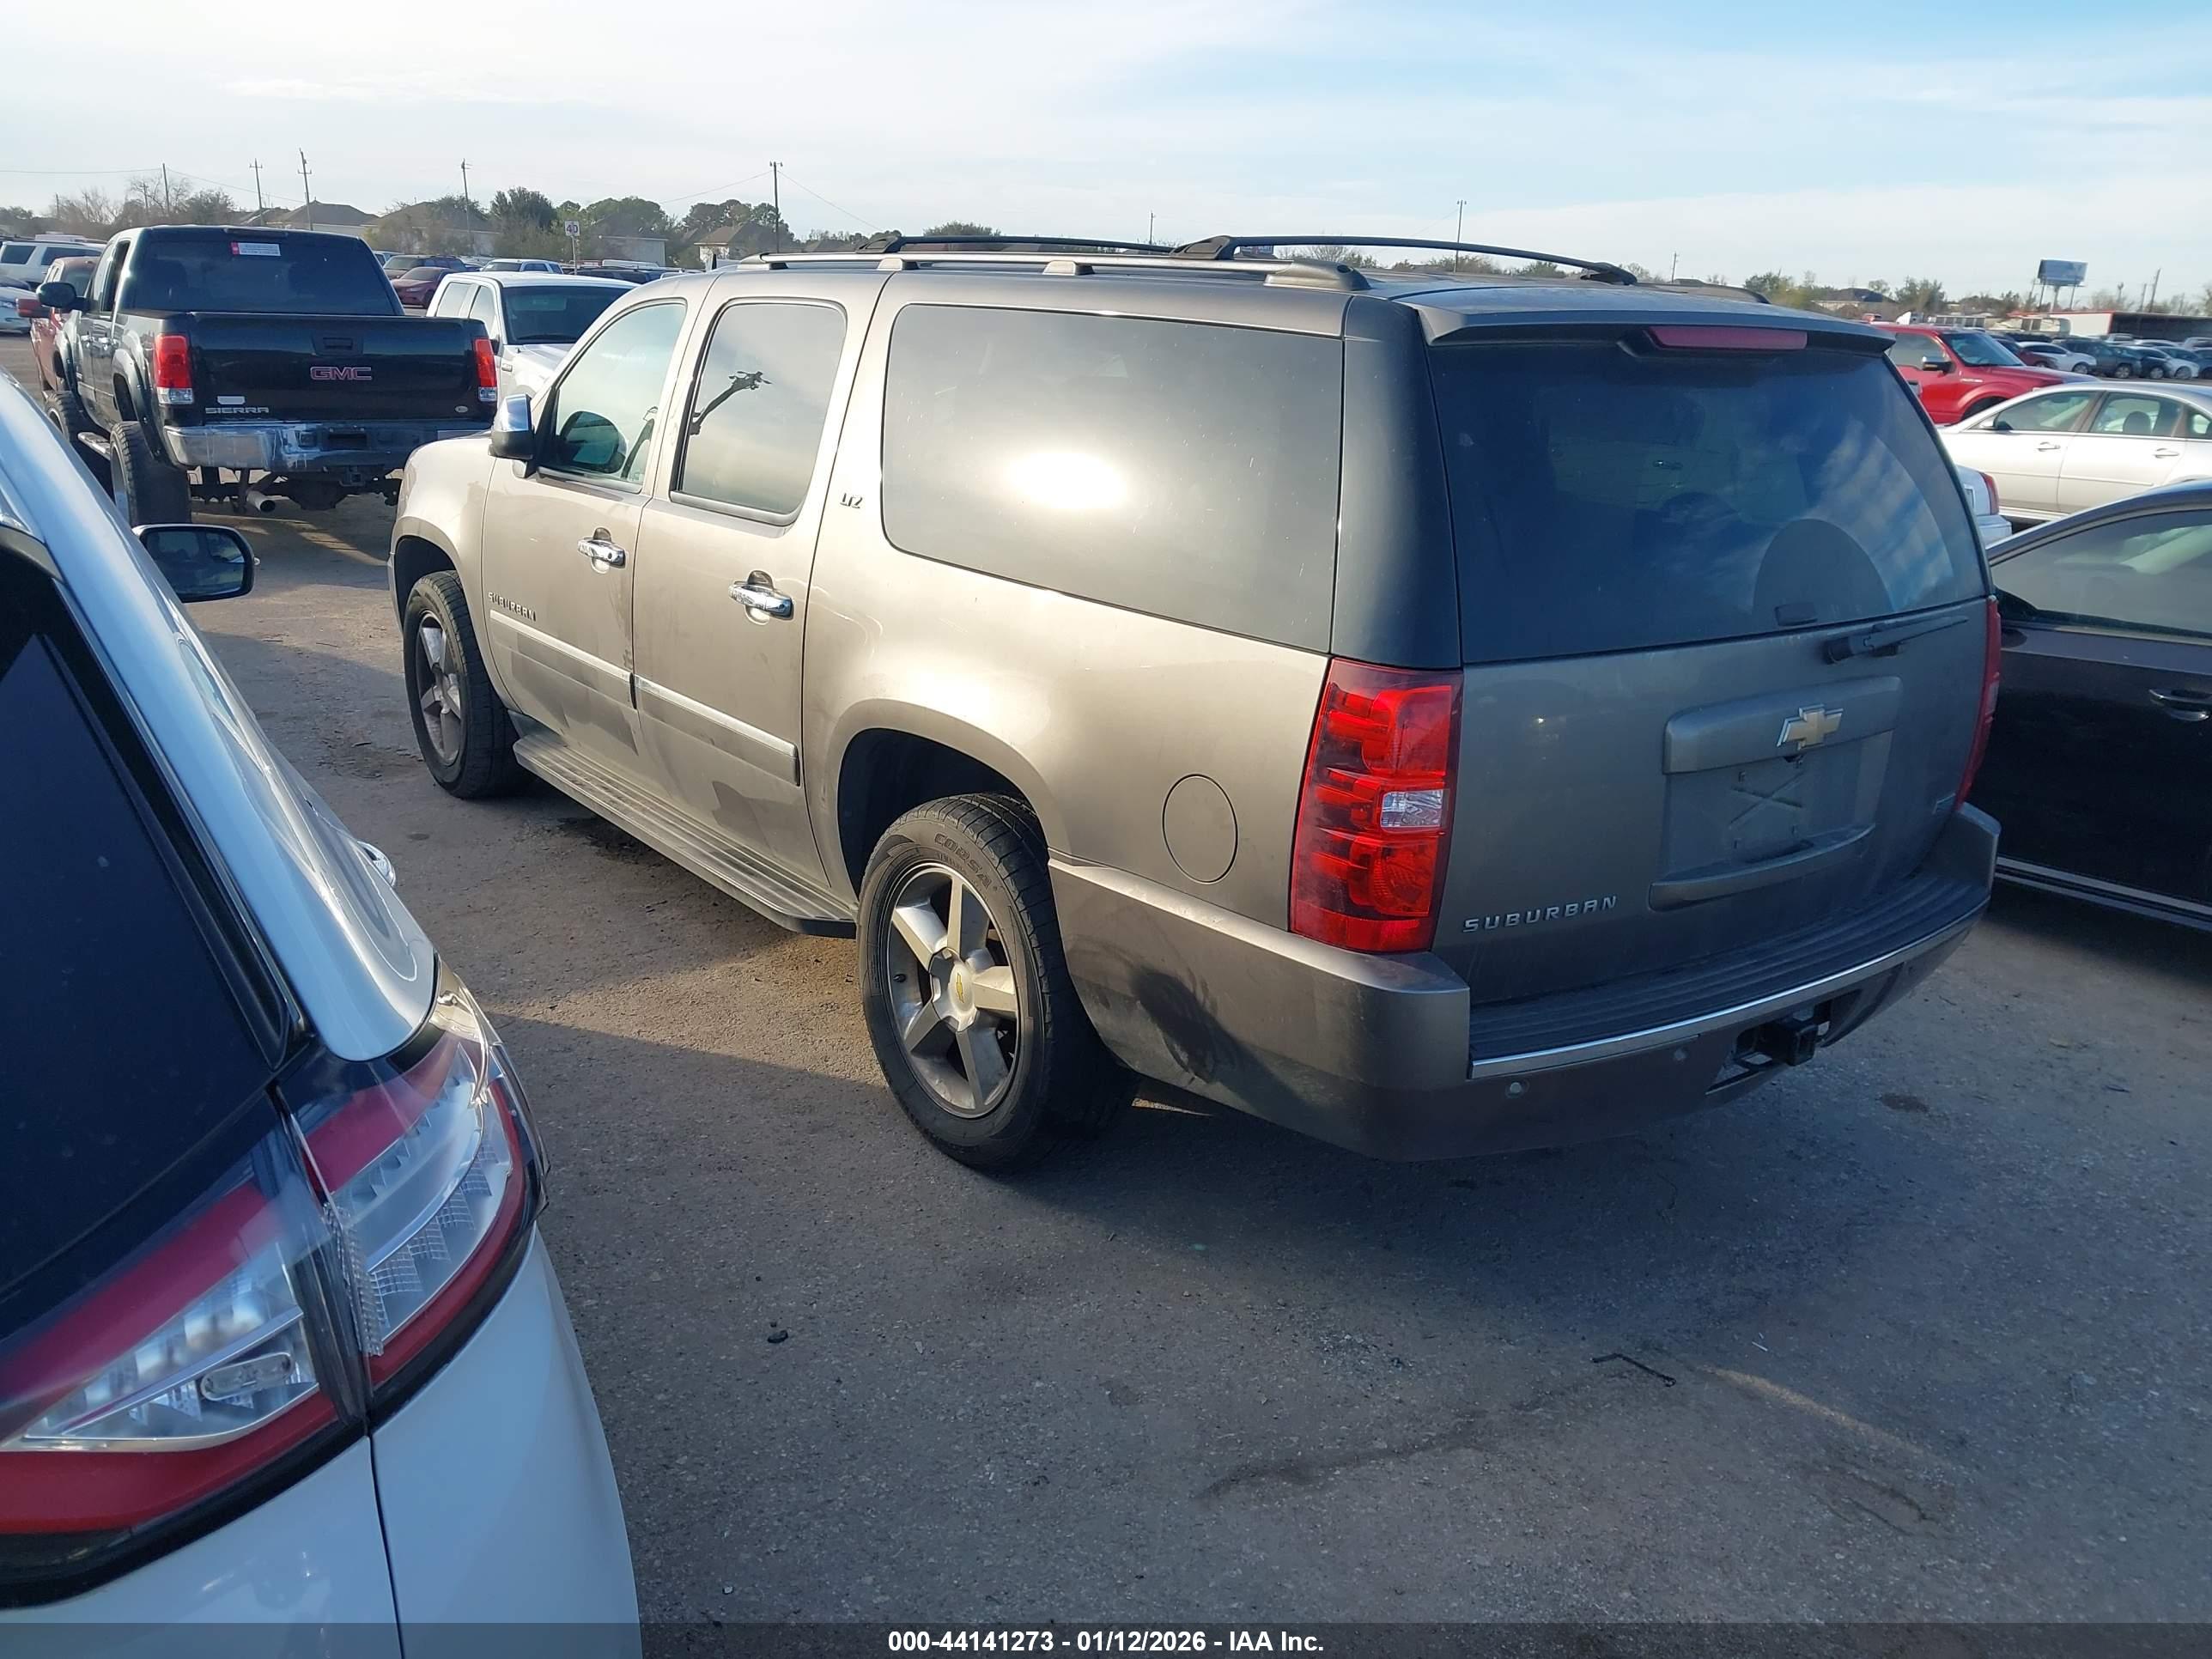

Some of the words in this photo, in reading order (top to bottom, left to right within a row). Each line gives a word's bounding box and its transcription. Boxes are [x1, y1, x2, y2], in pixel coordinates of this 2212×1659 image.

[310, 366, 373, 380] GMC
[488, 592, 537, 622] SUBURBAN
[1462, 895, 1617, 933] SUBURBAN
